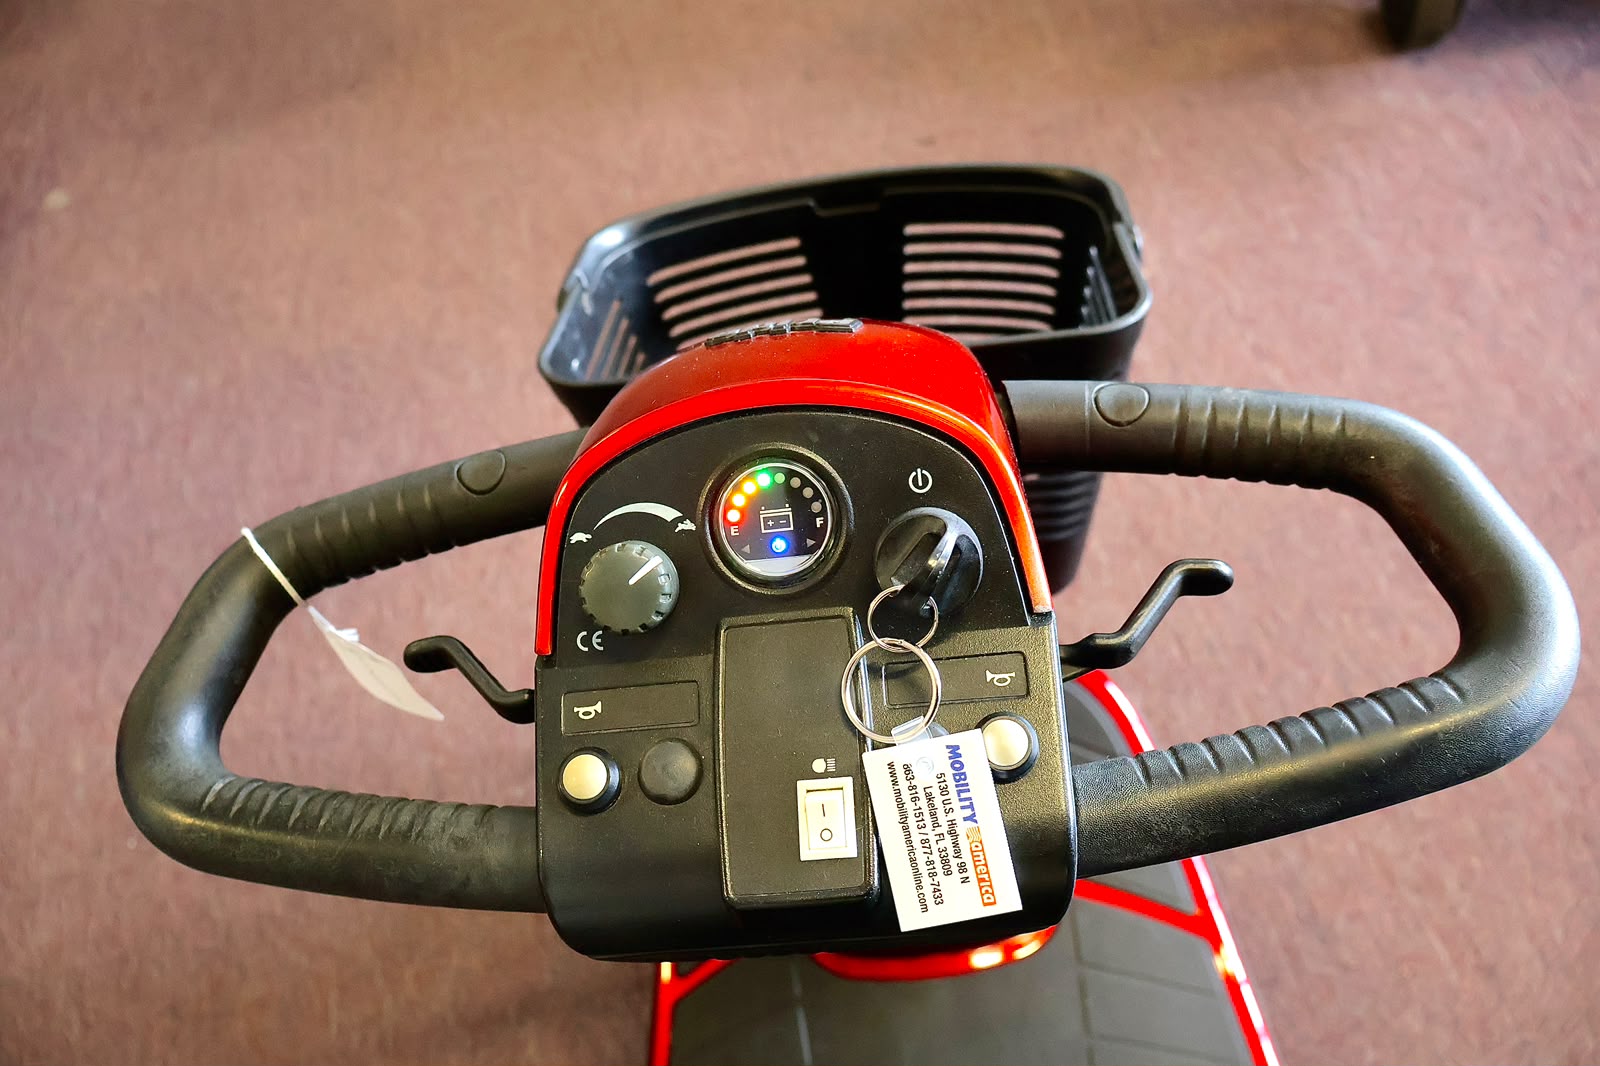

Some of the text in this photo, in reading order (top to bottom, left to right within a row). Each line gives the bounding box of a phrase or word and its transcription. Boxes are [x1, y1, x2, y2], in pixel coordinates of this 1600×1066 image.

[731, 526, 739, 536] E
[816, 517, 824, 528] F
[577, 630, 604, 651] CE
[886, 761, 929, 913] www.mobilityamericaonline.com
[902, 763, 927, 830] 863-816-1513
[920, 838, 944, 906] 877-818-7433
[923, 785, 953, 877] Lakeland, FL 33809
[935, 772, 971, 884] 5130 U.S. Highway 98 N
[945, 744, 995, 903] MOBILITY america
